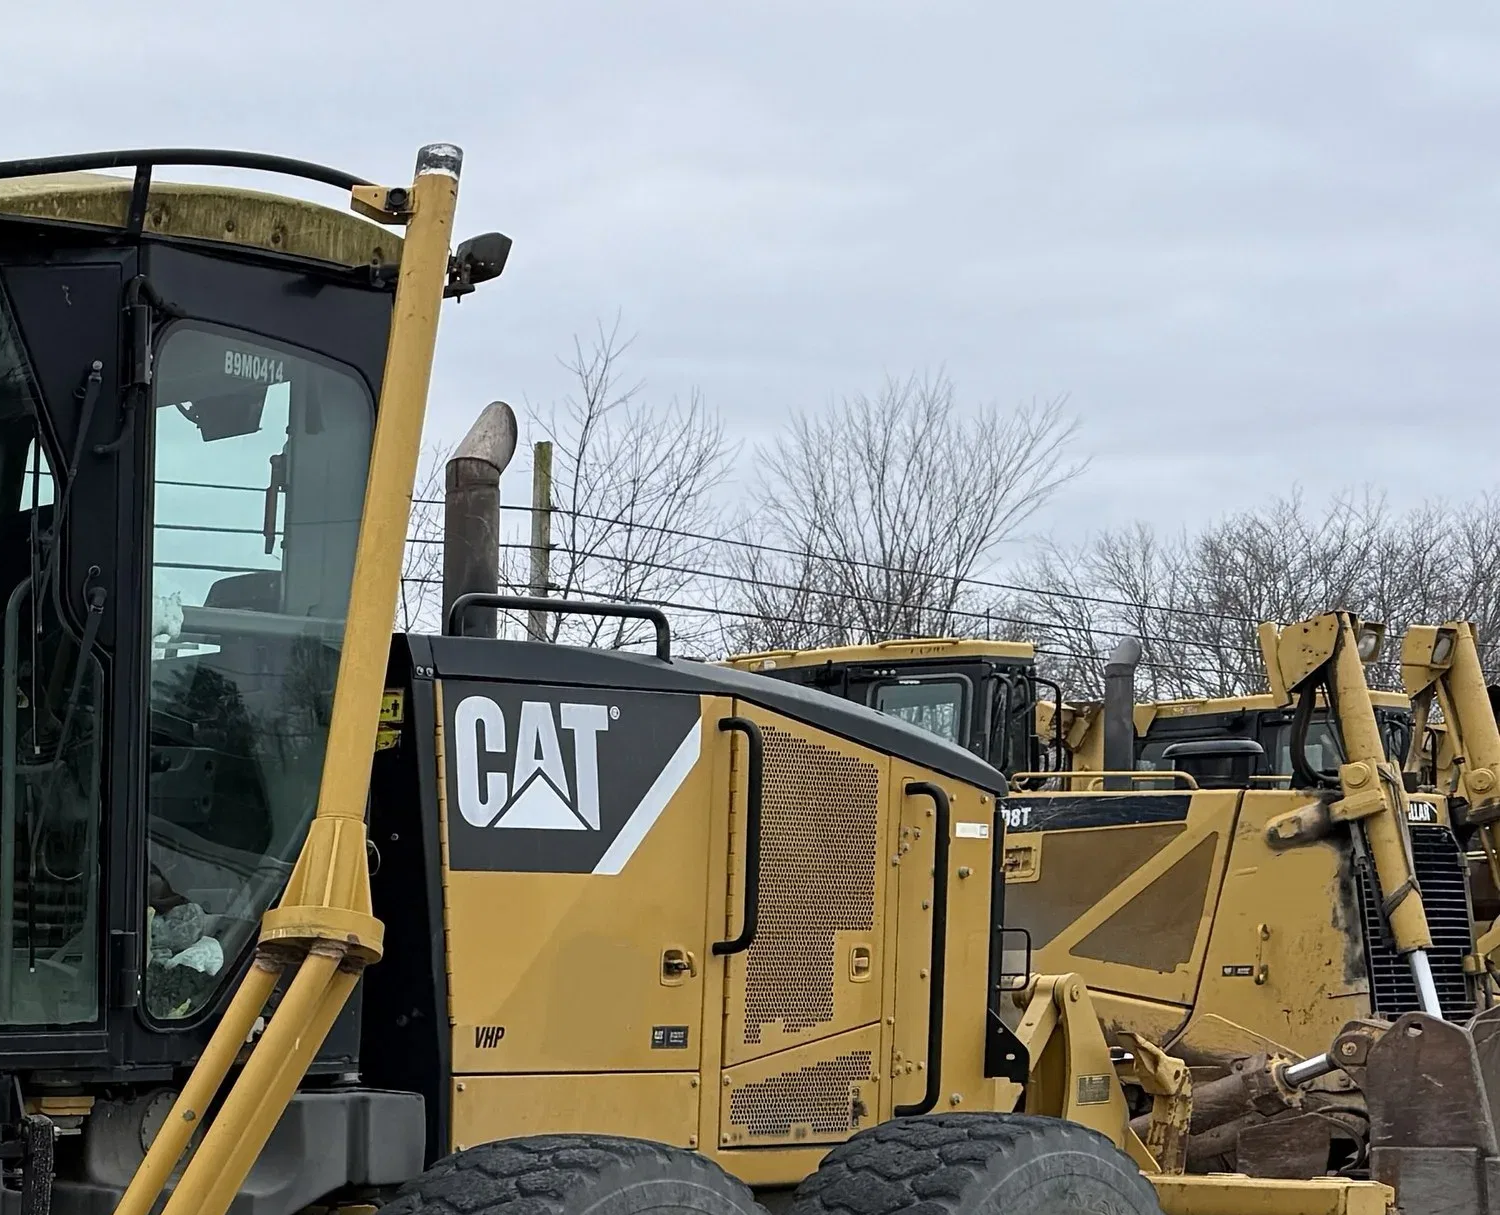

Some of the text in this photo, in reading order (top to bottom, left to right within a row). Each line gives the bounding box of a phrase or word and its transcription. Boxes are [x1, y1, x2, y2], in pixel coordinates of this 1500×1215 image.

[225, 350, 284, 383] B9M0414
[455, 695, 609, 832] CAT
[475, 1026, 505, 1048] VHP
